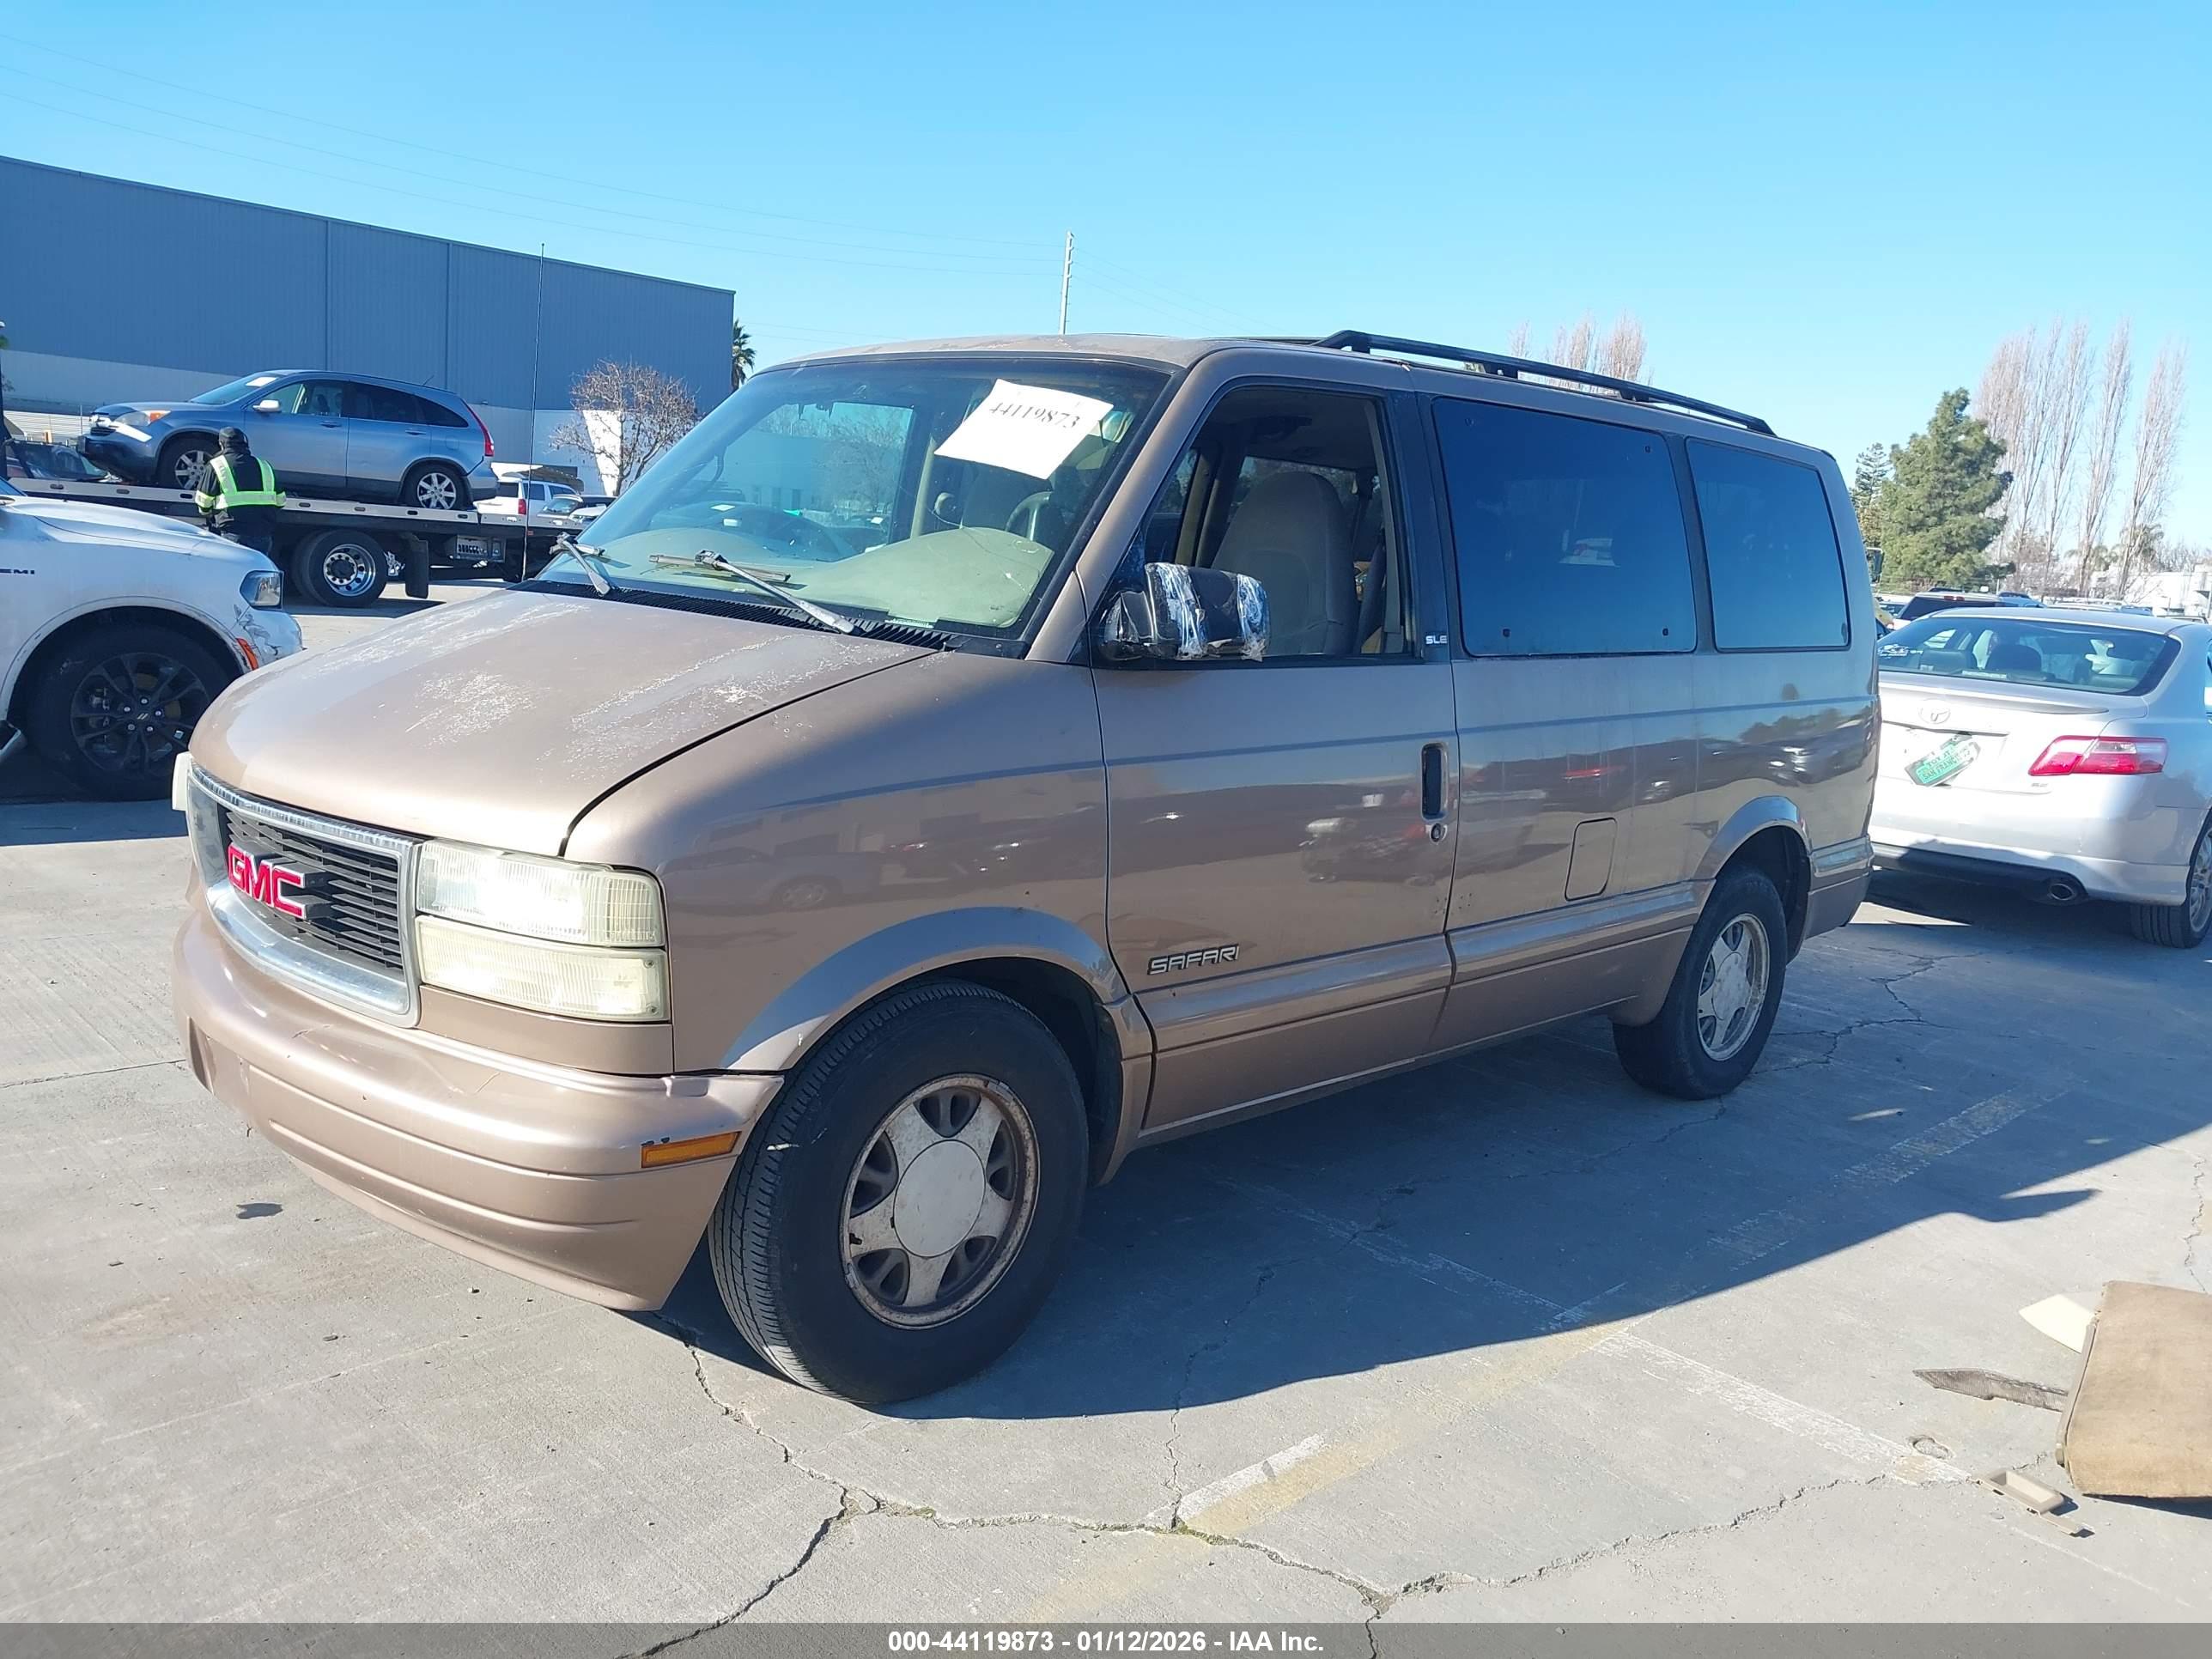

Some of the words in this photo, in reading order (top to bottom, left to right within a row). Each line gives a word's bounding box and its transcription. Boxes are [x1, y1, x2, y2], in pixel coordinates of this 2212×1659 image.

[989, 401, 1081, 429] 44119873
[1425, 635, 1448, 645] SLE
[228, 842, 307, 920] GMC
[1147, 944, 1240, 975] SAFARI
